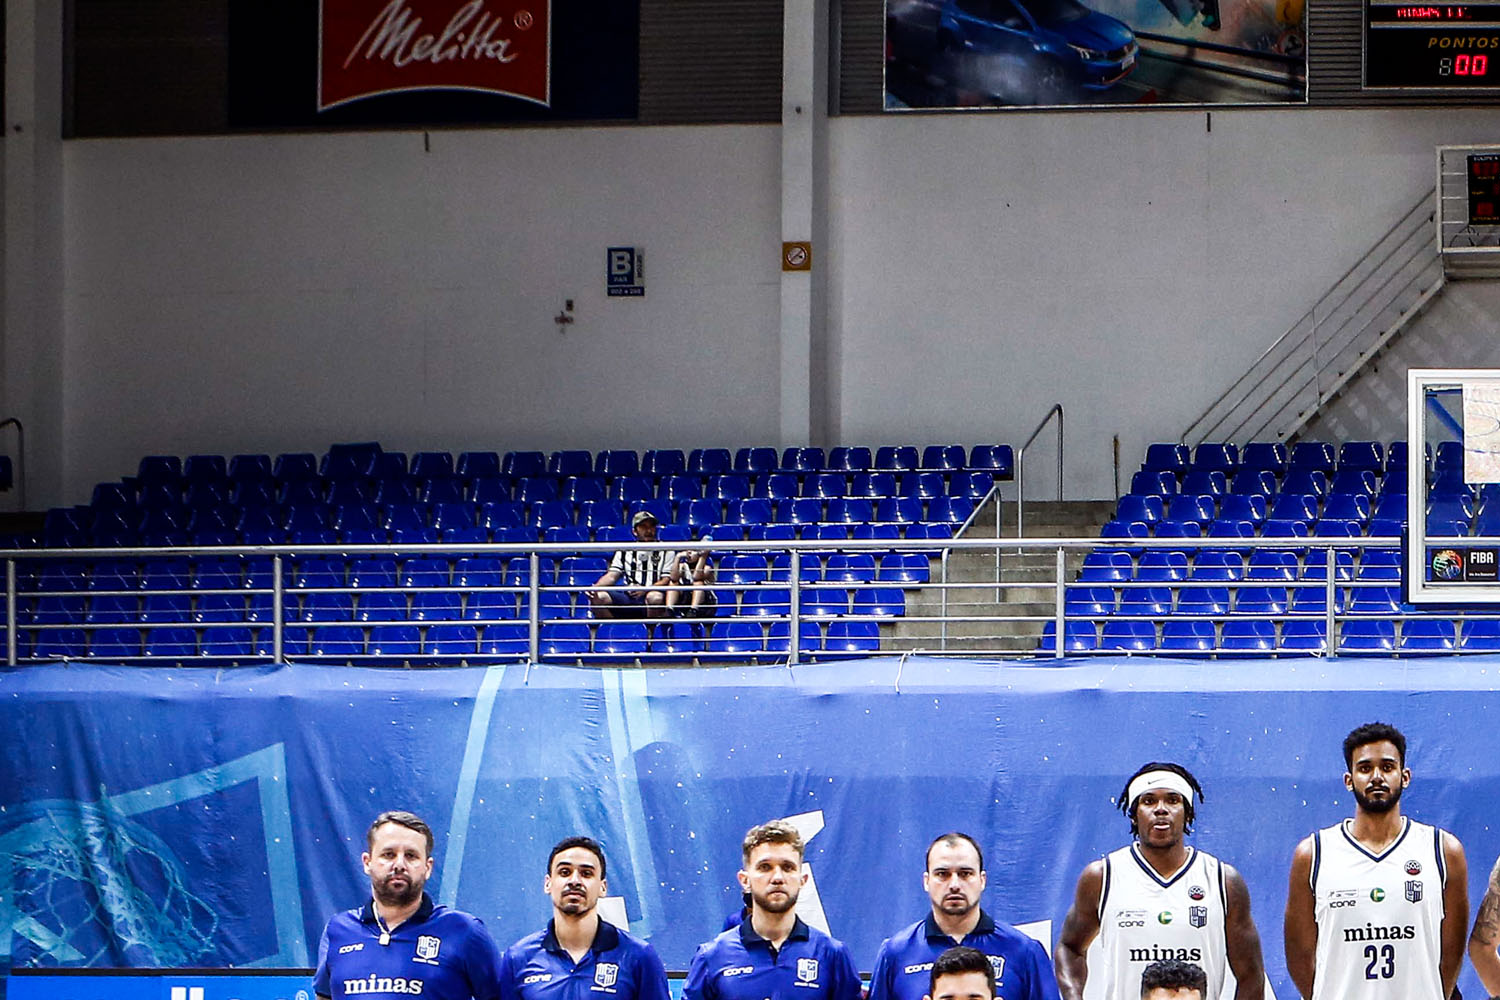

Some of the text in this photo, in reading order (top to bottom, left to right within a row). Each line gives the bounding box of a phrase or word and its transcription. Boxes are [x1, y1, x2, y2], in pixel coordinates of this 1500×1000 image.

[343, 0, 519, 69] Melitta
[1427, 36, 1500, 49] PONTOS
[611, 251, 631, 274] B
[1470, 551, 1494, 564] FIBA
[1343, 922, 1415, 942] minas
[1129, 943, 1201, 961] minas
[1363, 944, 1395, 980] 23
[343, 974, 424, 995] minas
